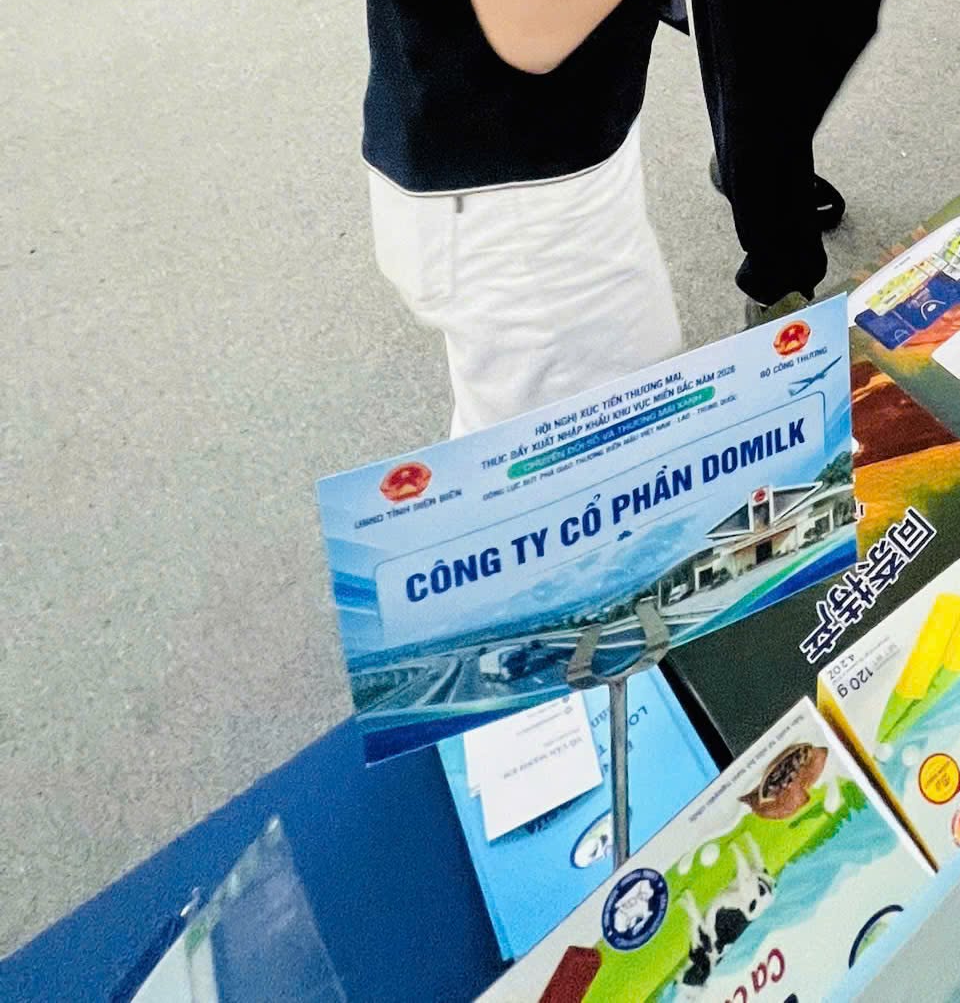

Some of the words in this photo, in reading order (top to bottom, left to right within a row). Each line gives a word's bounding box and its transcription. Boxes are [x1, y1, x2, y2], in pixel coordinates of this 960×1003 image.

[535, 422, 552, 436] HỘI
[554, 413, 577, 429] NGHỊ
[625, 379, 663, 400] THƯƠNG
[406, 546, 501, 602] CÔNG
[511, 528, 548, 565] TY
[560, 493, 602, 547] CỔ
[612, 464, 693, 525] PHẦN
[702, 418, 806, 483] DOMILK
[800, 509, 936, 663] 同奈特产
[835, 683, 850, 698] g
[847, 666, 874, 691] 120
